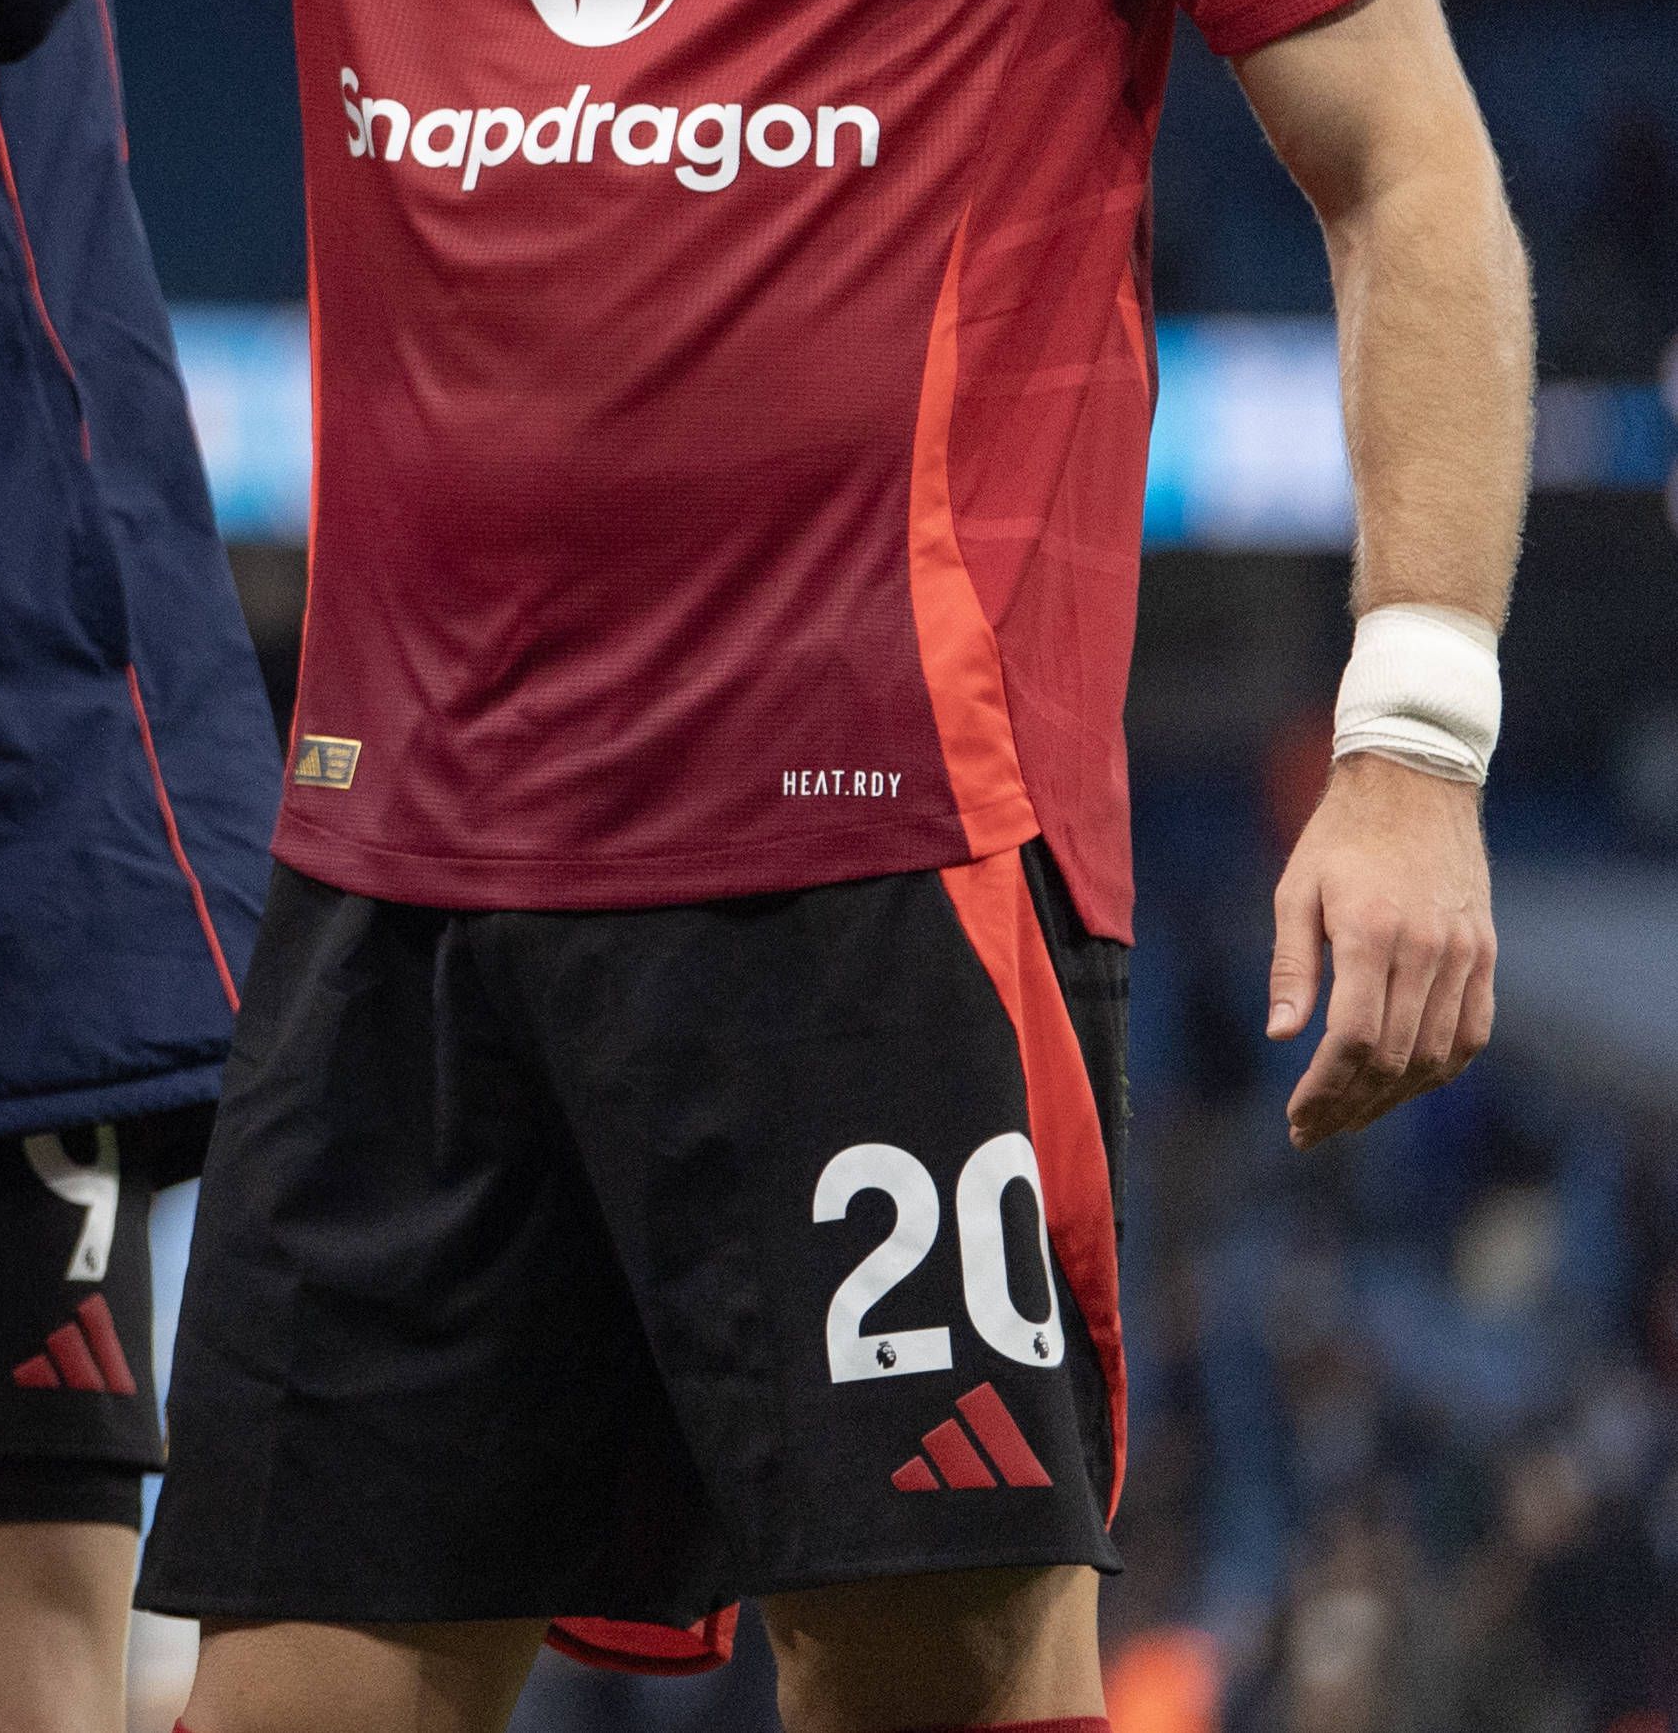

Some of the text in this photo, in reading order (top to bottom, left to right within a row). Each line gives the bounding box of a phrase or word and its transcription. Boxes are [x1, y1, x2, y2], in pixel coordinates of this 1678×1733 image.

[340, 66, 880, 192] Snapdragon
[783, 769, 902, 798] HEAT.RDY
[812, 1130, 1065, 1384] 20
